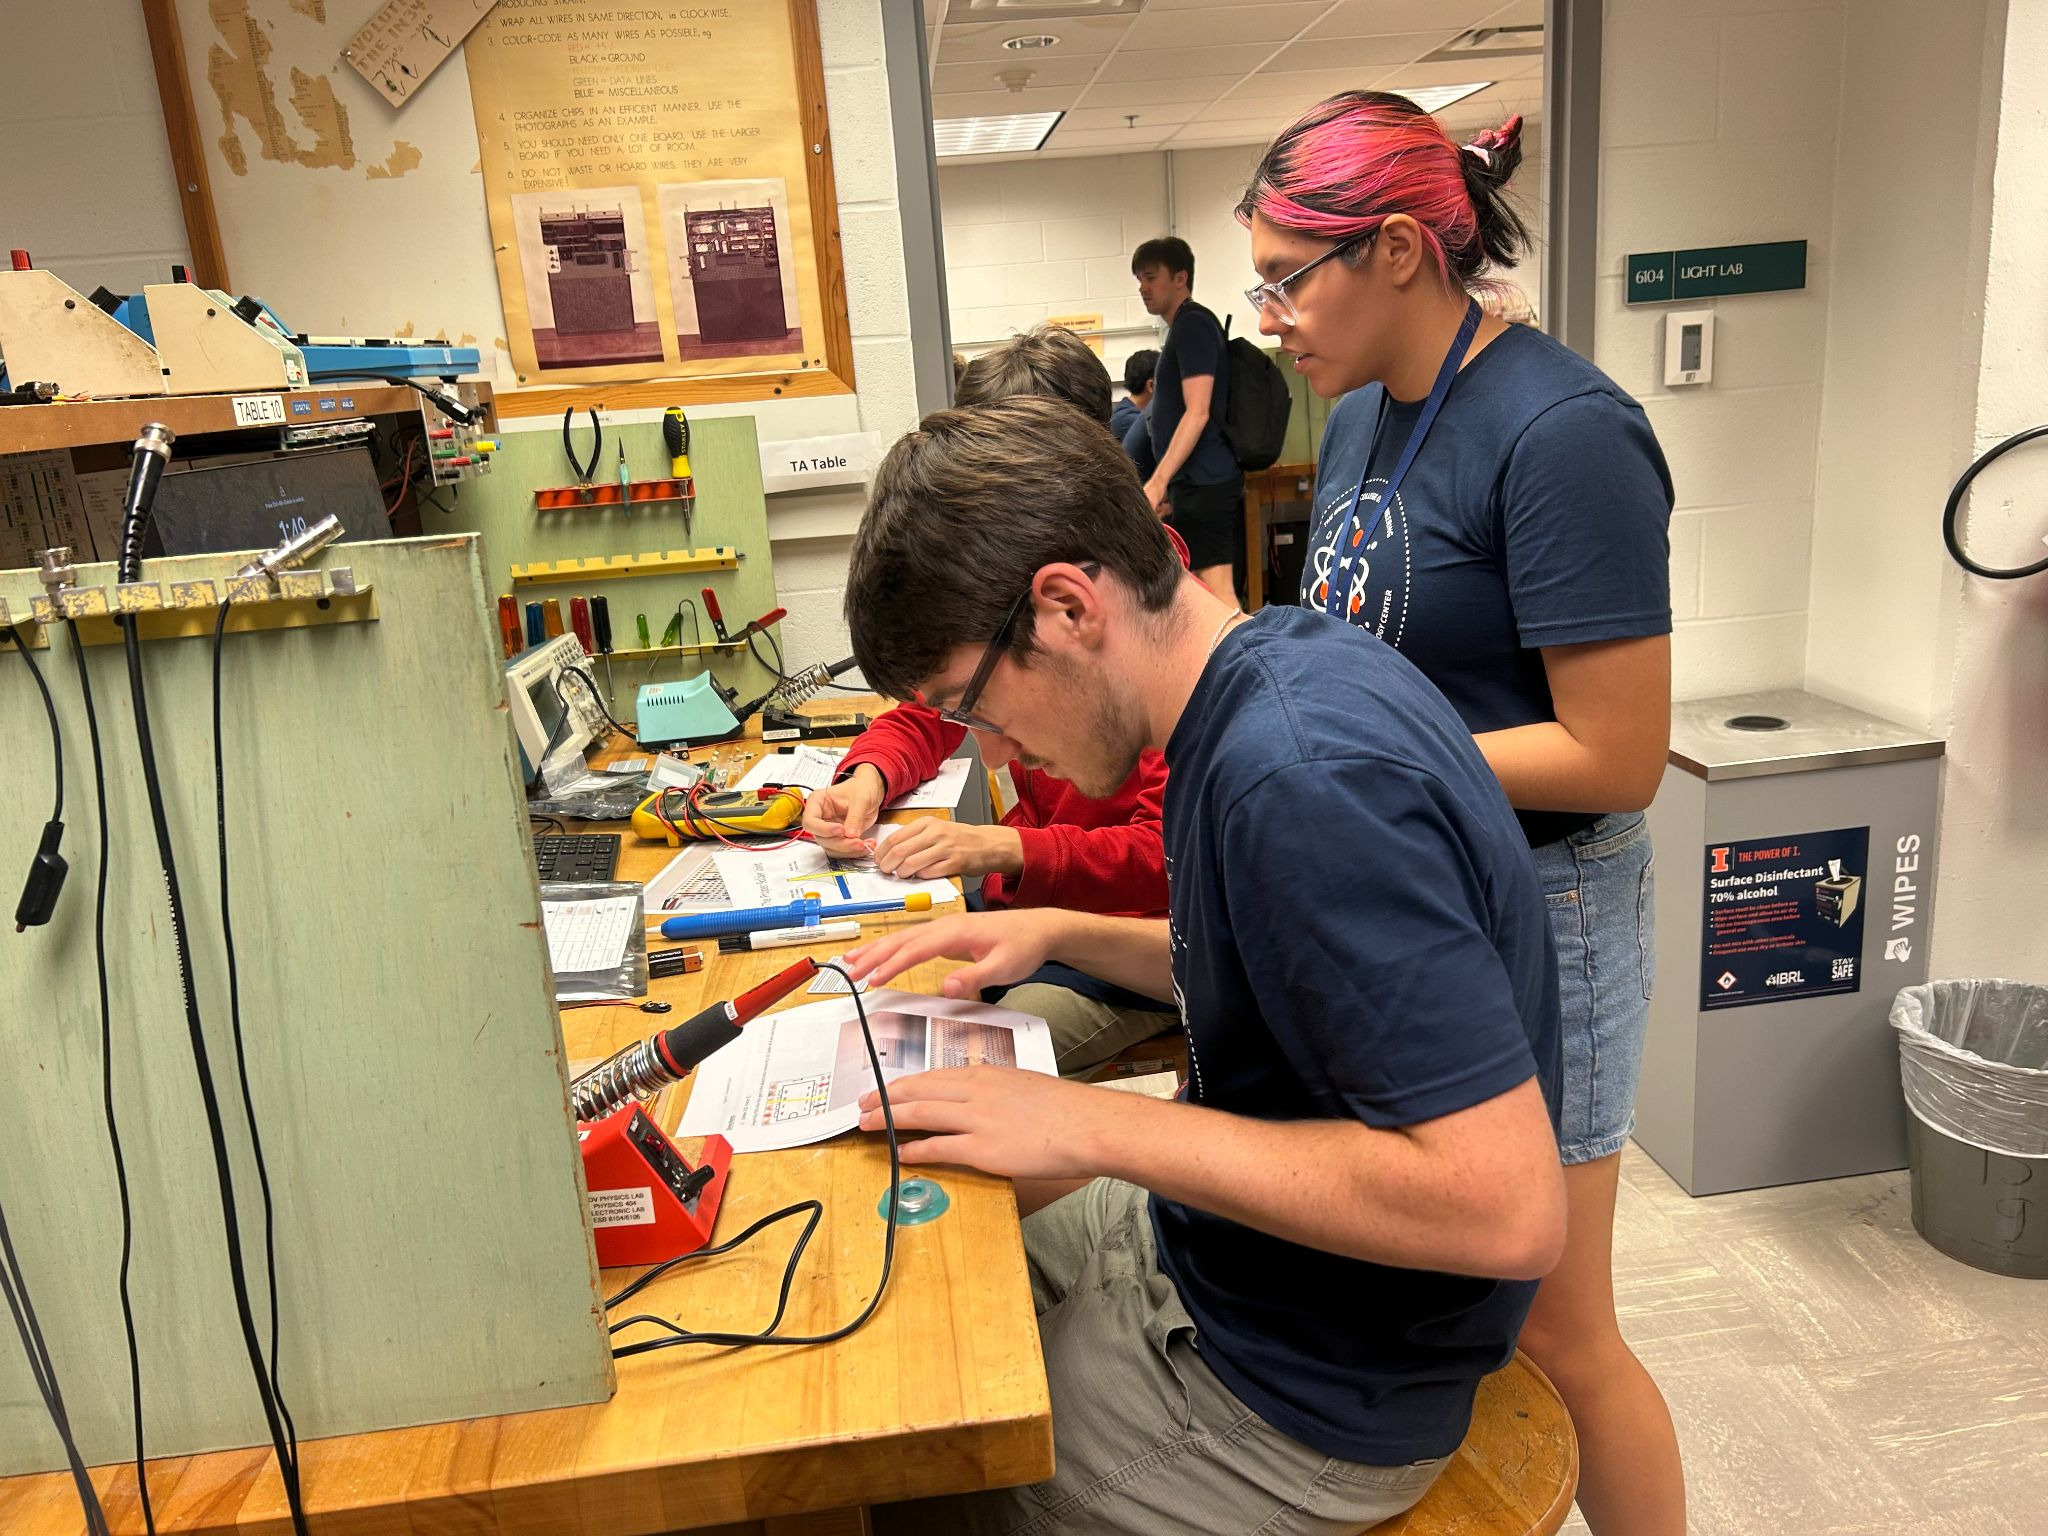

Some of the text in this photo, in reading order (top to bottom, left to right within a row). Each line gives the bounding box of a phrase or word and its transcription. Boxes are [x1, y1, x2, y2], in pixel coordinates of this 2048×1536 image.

[500, 18, 525, 28] WRAP
[530, 16, 544, 25] ALL
[547, 14, 574, 24] WIRES
[577, 14, 585, 22] IN
[588, 12, 614, 22] SAME
[618, 10, 662, 20] DIRECTION,
[502, 34, 562, 46] COLOR-CODE
[568, 32, 578, 41] AS
[582, 31, 609, 40] MANY
[615, 30, 640, 40] WIRES
[644, 29, 656, 38] AS
[356, 39, 388, 71] THE
[569, 54, 599, 64] BLACK
[608, 53, 646, 63] GROUND
[573, 77, 599, 87] GREEN
[610, 76, 632, 86] DATA
[636, 75, 658, 84] LINES
[574, 89, 595, 98] BLUE
[608, 86, 679, 96] MISCELLANEOUS
[514, 110, 558, 120] ORGANIZE
[562, 108, 584, 117] CHIPS
[590, 107, 598, 116] IN
[603, 106, 616, 114] AN
[620, 104, 656, 114] EFFICIENT
[708, 101, 722, 110] USE
[727, 100, 742, 110] THE
[515, 120, 578, 132] PHOTOGRAPHS
[584, 118, 594, 128] AS
[598, 118, 612, 126] AN
[518, 140, 537, 150] YOU
[542, 138, 575, 148] SHOULD
[578, 136, 598, 146] NEED
[602, 134, 624, 144] ONLY
[630, 133, 648, 142] ONE
[692, 130, 706, 140] USE
[712, 129, 726, 138] THE
[730, 128, 761, 138] LARGER
[520, 150, 550, 161] BOARD
[554, 150, 561, 158] IF
[566, 148, 584, 158] YOU
[590, 146, 611, 156] NEED
[616, 146, 624, 154] A
[628, 144, 644, 154] LOT
[650, 143, 662, 152] OF
[522, 168, 536, 178] DO
[542, 168, 561, 177] NOT
[566, 164, 593, 176] WASTE
[598, 164, 611, 173] OR
[616, 162, 647, 172] HOARD
[683, 160, 703, 169] THEY
[708, 158, 723, 168] ARE
[729, 157, 748, 166] VERY
[524, 176, 570, 190] EXPENSIVE!
[1635, 263, 1744, 284] 6104 LIGHT LAB
[237, 399, 282, 422] TABLE 10
[790, 456, 846, 472] TA Table
[1380, 589, 1392, 624] CENTER
[1738, 852, 1752, 862] THE
[1754, 848, 1780, 860] POWER
[1782, 846, 1792, 858] OF
[1710, 866, 1824, 889] Surface Disinfectant
[1892, 834, 1920, 931] WIPES
[1710, 886, 1778, 904] 70% alcohol
[1832, 958, 1854, 966] STAY
[1776, 970, 1804, 985] IBRL
[1832, 964, 1854, 979] SAFE
[592, 1208, 631, 1216] LECTRONIC
